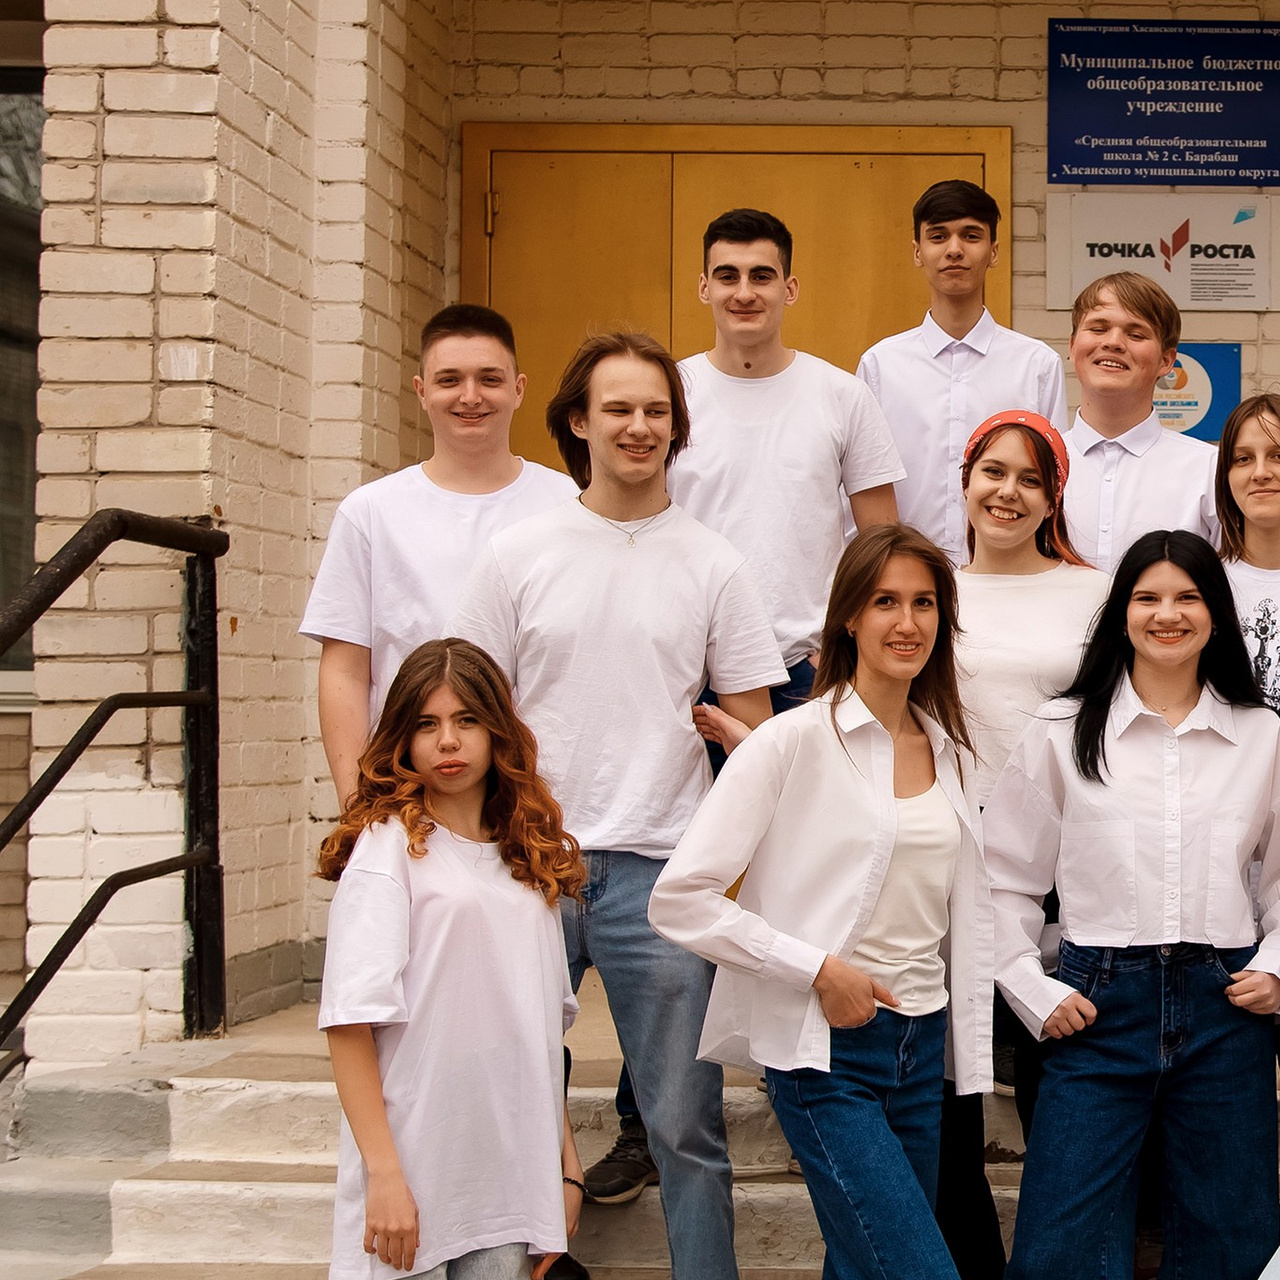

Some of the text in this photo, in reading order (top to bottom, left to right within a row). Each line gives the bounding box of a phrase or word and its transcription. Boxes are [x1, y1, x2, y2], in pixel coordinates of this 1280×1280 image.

[1057, 24, 1130, 34] Администрация
[1132, 24, 1184, 33] Хасанского
[1186, 26, 1261, 35] муниципального
[1060, 53, 1194, 71] Муниципальное
[1087, 75, 1264, 94] общеобразовательное
[1126, 99, 1224, 115] учреждение
[1074, 134, 1267, 149] «Средняя общеобразовательная
[1103, 151, 1142, 161] школа
[1145, 150, 1159, 161] №
[1162, 151, 1169, 161] 2
[1185, 151, 1239, 164] Барабаш
[1062, 164, 1131, 176] Хасанского
[1134, 166, 1236, 178] муниципального
[1086, 242, 1256, 259] ТОЧКА РОСТА
